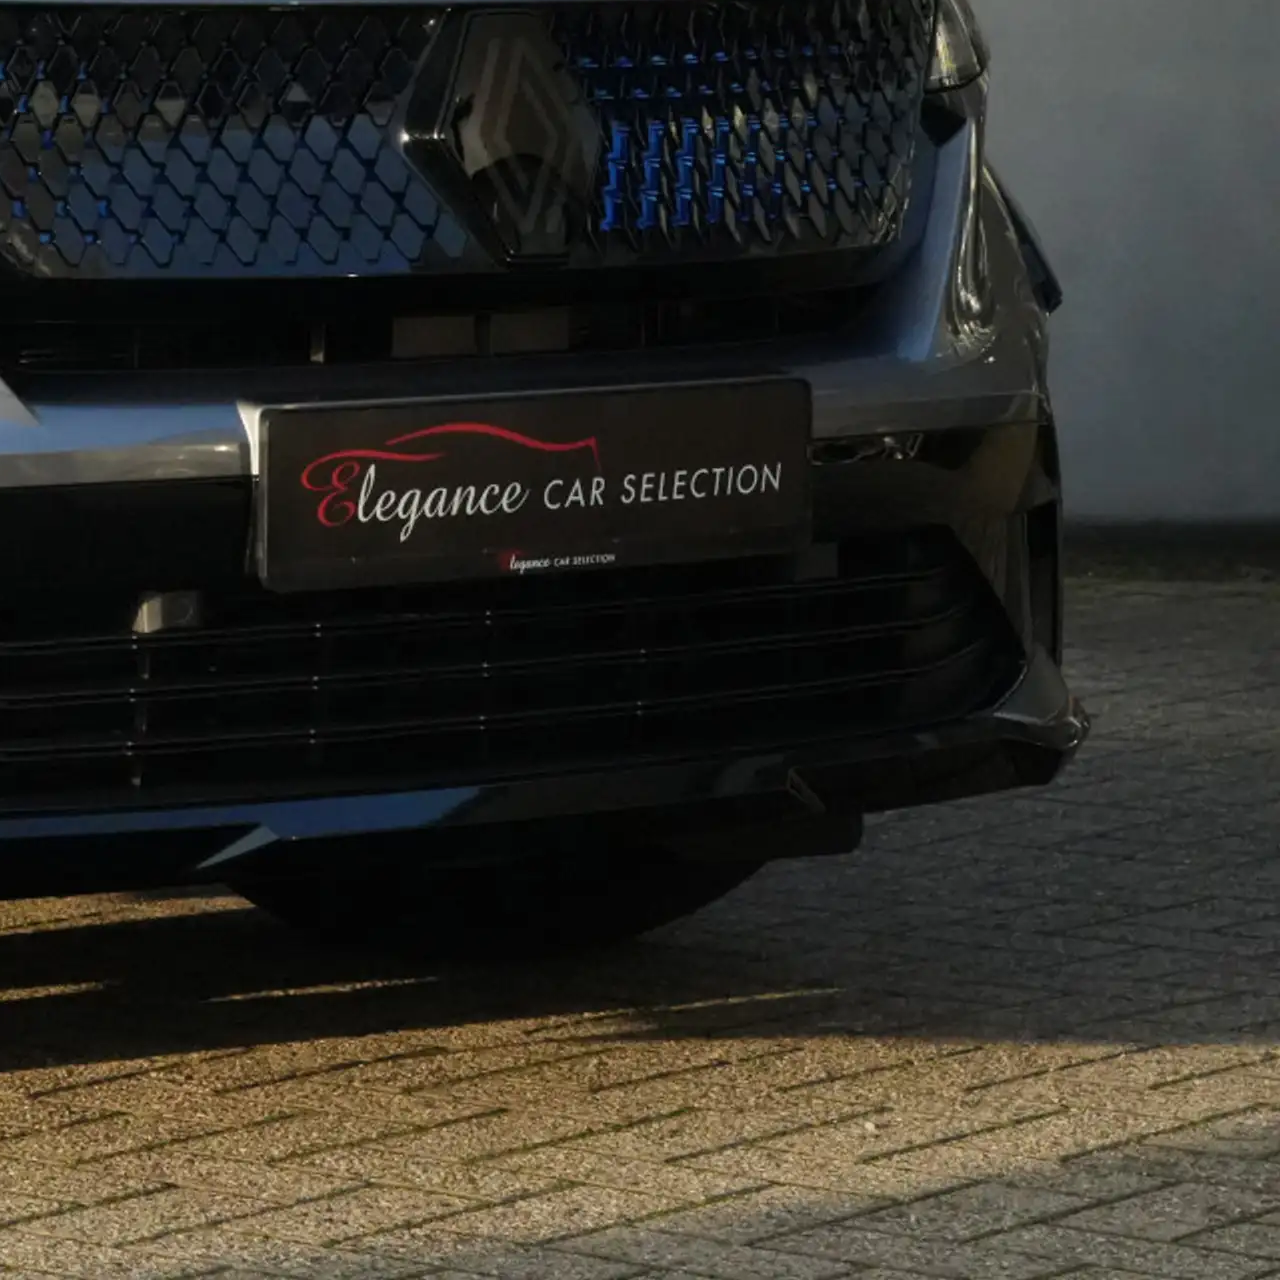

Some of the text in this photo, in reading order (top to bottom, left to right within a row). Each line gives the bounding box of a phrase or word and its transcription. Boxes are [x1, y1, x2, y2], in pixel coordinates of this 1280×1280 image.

[300, 449, 783, 544] Elegance CAR SELECTION
